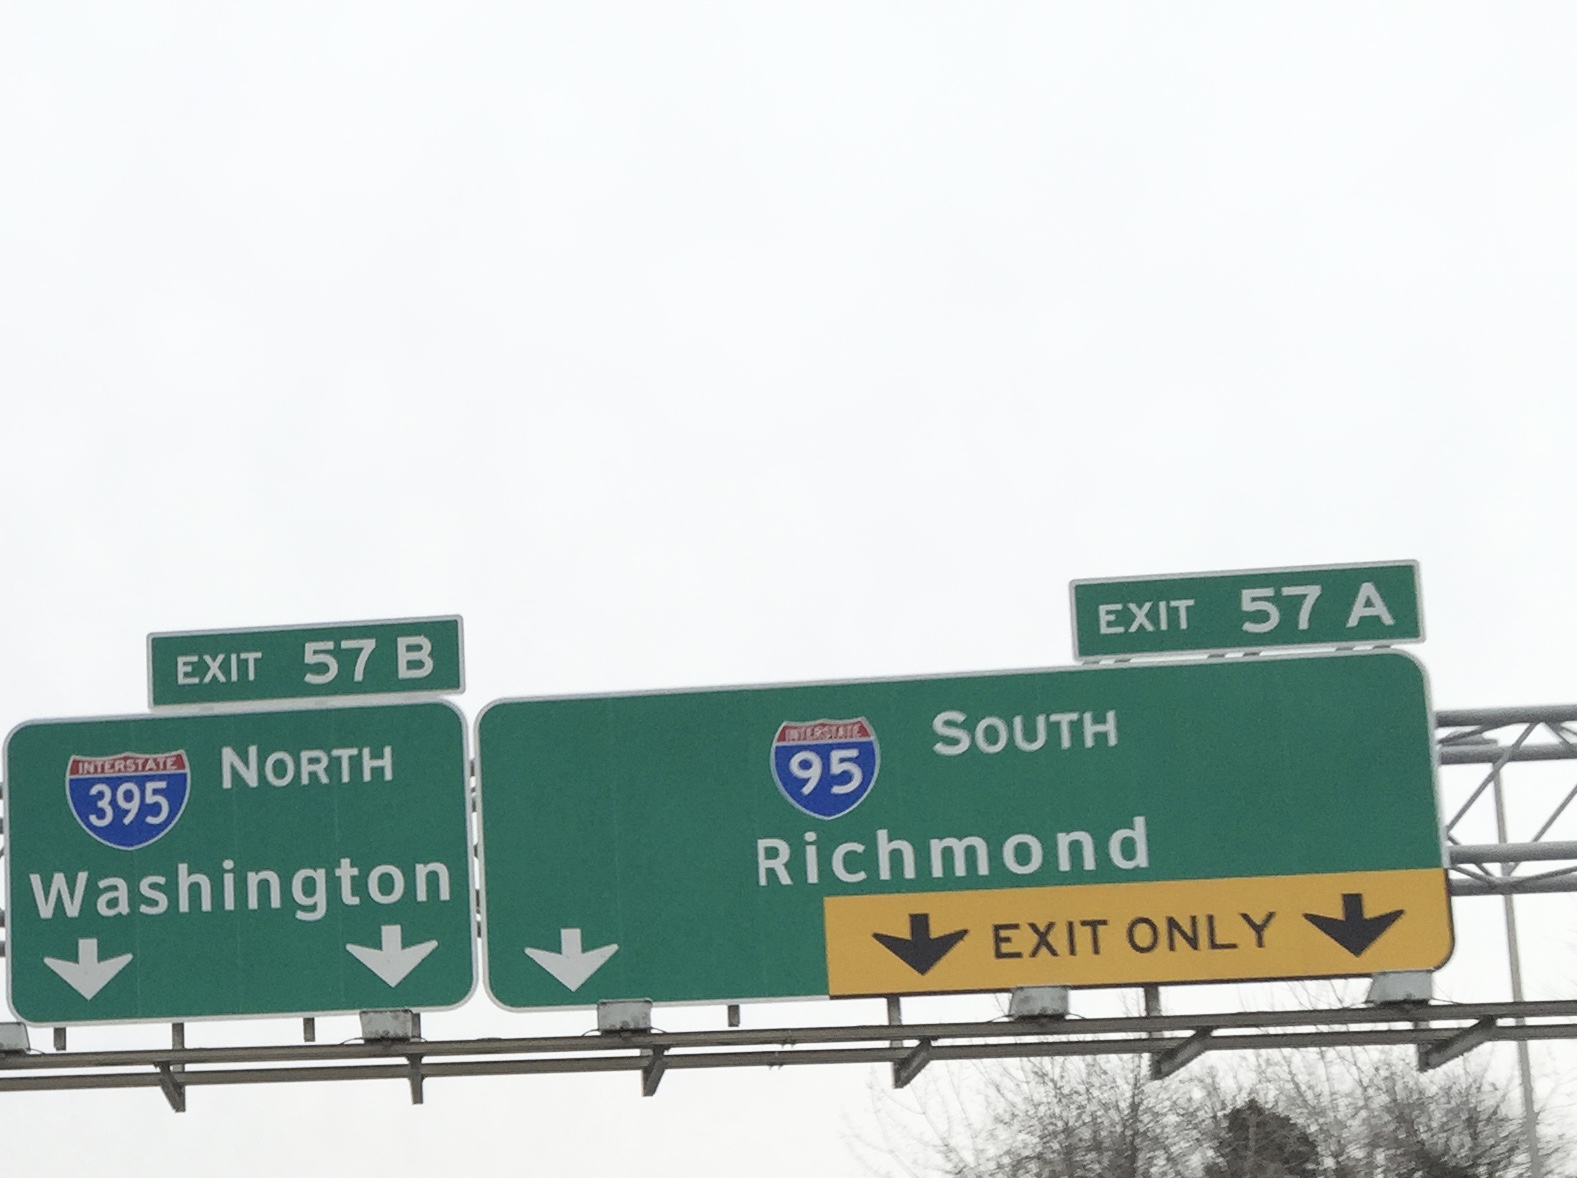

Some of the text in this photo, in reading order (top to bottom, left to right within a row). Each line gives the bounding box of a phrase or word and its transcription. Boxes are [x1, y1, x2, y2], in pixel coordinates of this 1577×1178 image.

[1098, 581, 1394, 635] EXIT 57 A
[177, 635, 434, 685] EXIT 57 B
[78, 755, 178, 775] INTERSTATE
[789, 748, 864, 796] 95
[89, 780, 170, 828] 395
[756, 816, 1150, 887] Richmond
[29, 859, 451, 921] Washington
[993, 911, 1277, 960] EXIT ONLY
